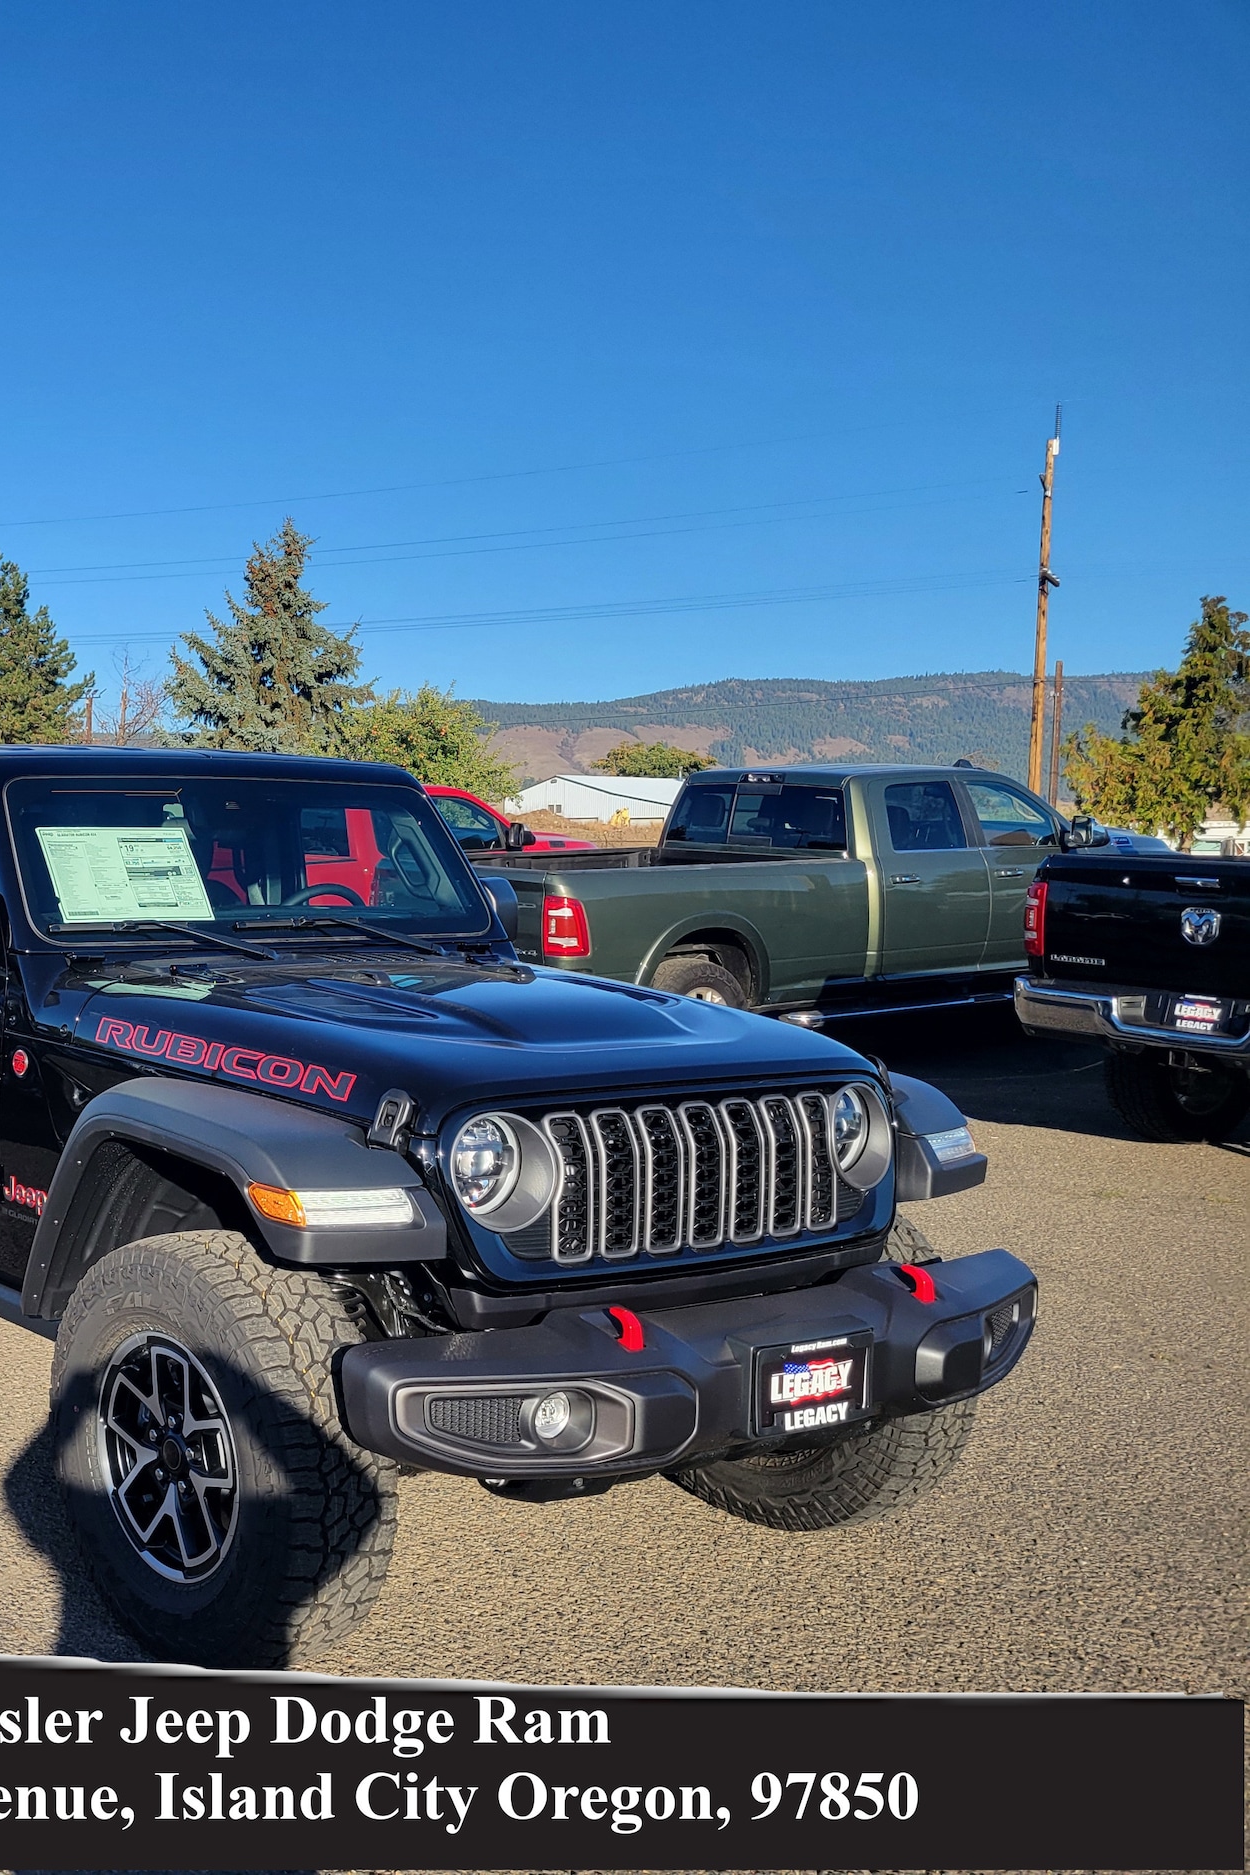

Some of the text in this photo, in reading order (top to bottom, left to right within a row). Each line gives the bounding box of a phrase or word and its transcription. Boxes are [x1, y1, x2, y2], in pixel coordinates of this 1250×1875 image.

[124, 844, 134, 852] 19
[1051, 954, 1105, 966] LARAMIE
[1174, 1003, 1222, 1020] LEGACY
[1176, 1019, 1214, 1031] LEGACY
[95, 1017, 358, 1102] RUBICON
[3, 1175, 47, 1216] Jeep
[771, 1362, 852, 1400] LEGACY
[784, 1402, 849, 1431] LEGACY
